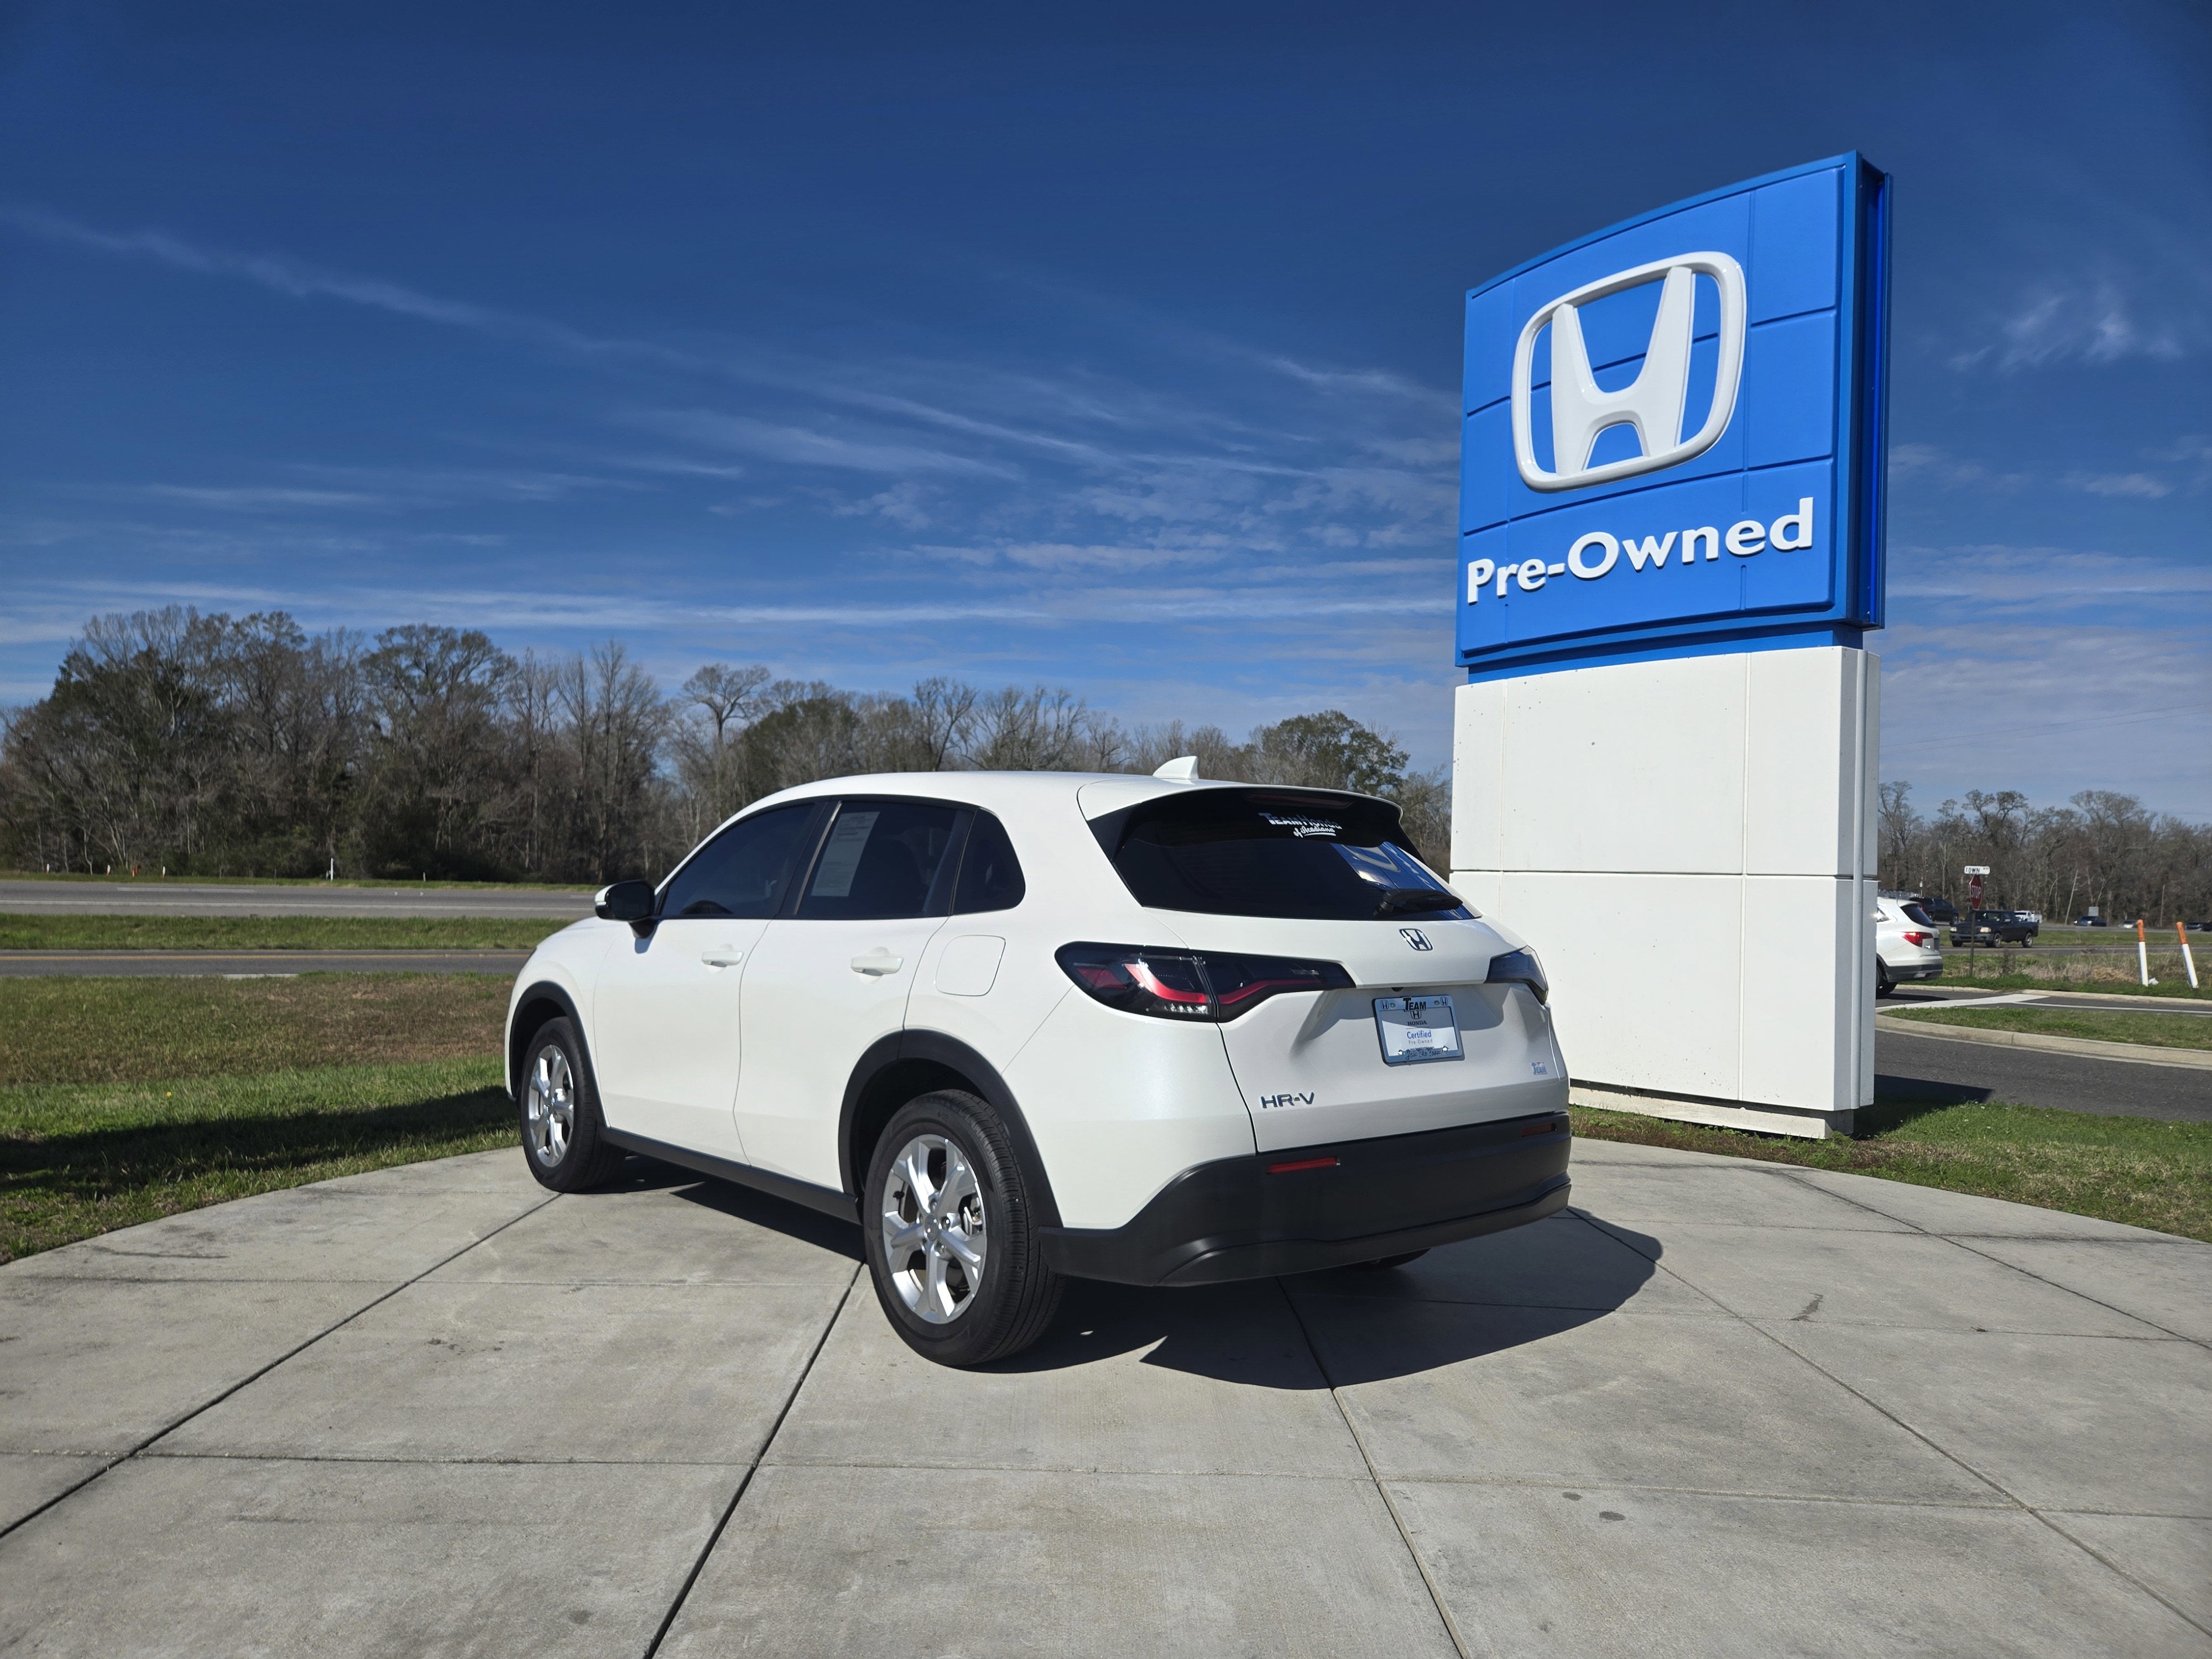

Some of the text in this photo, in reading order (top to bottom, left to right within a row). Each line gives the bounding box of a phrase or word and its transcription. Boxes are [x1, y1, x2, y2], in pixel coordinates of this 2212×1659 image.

[1467, 497, 1814, 603] Pre-Owned
[1971, 885, 1981, 899] STOP
[1403, 998, 1427, 1010] TEAM
[1407, 1030, 1432, 1039] Certified
[1261, 1092, 1314, 1108] HR-V
